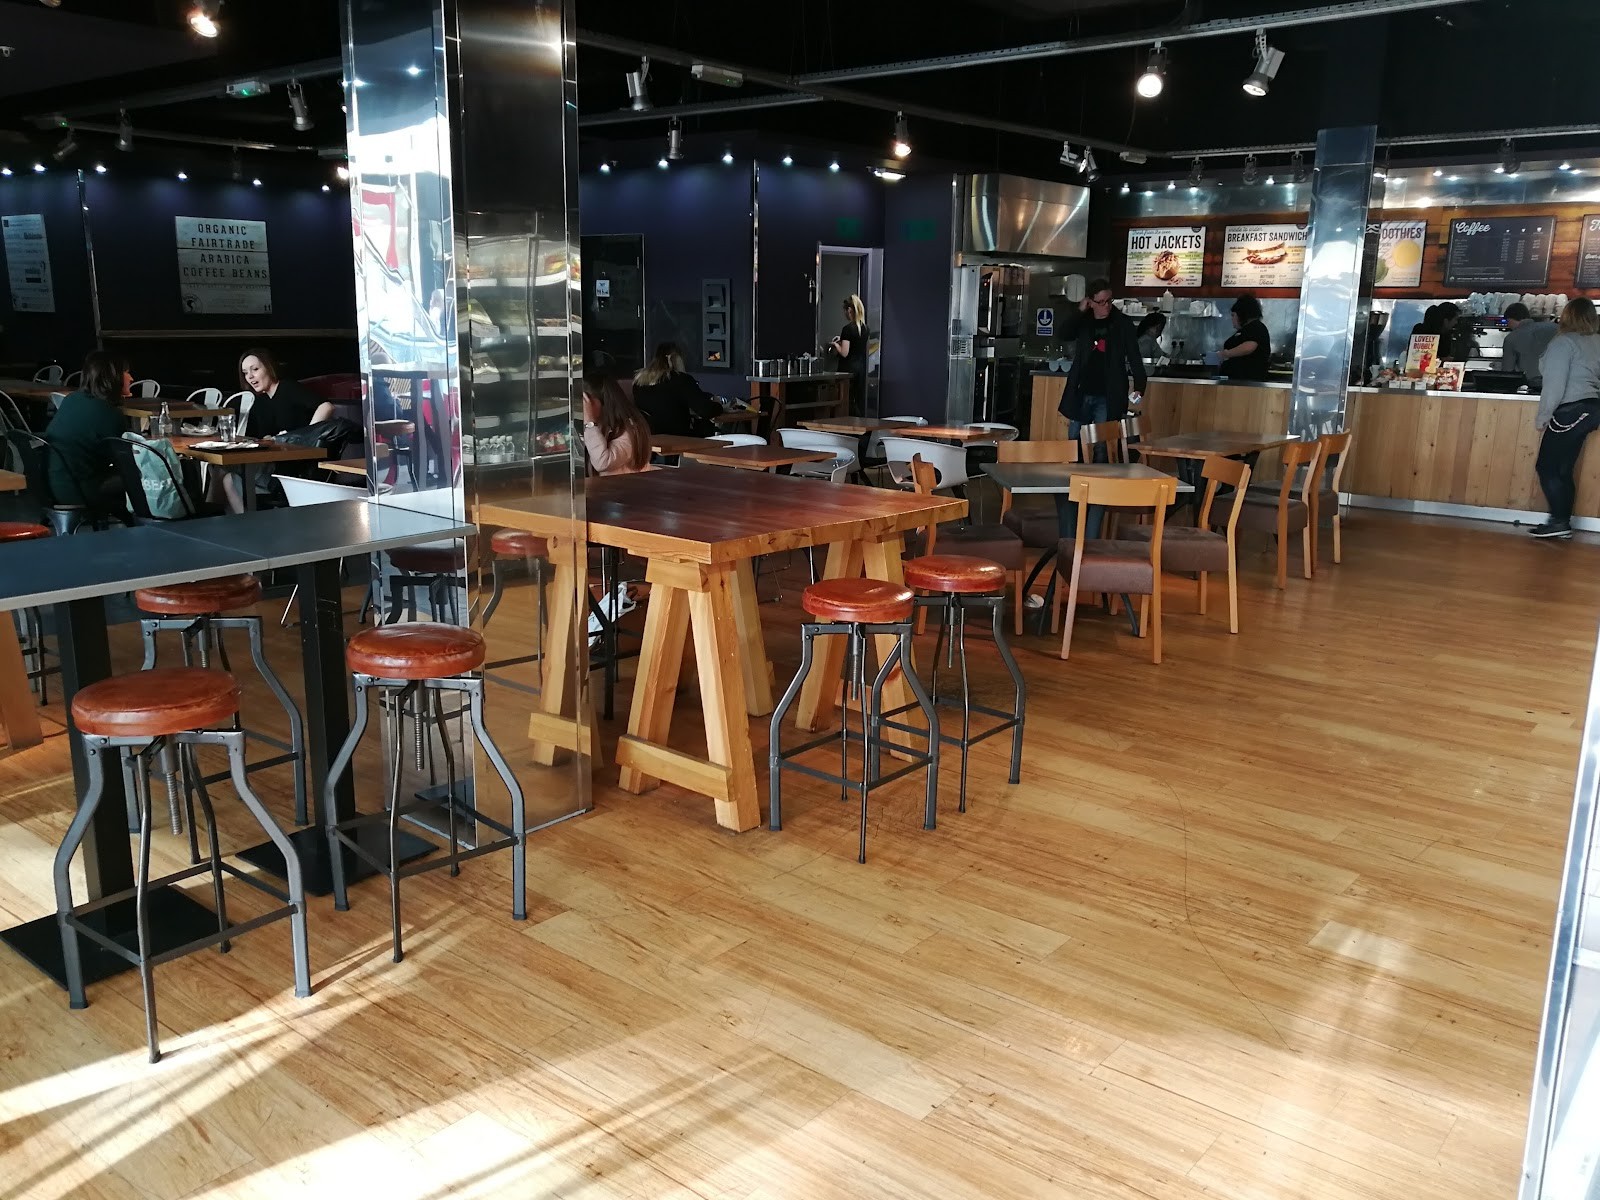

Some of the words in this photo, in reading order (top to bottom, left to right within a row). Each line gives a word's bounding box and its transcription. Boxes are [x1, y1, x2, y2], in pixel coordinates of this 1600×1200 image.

[197, 223, 247, 236] ORGANIC
[1381, 227, 1423, 239] OOTHIES
[1455, 221, 1491, 236] Coffee
[1131, 236, 1152, 250] HOT
[1154, 235, 1202, 249] JACKETS
[1227, 232, 1267, 243] BREAKFAST
[1268, 231, 1308, 242] SANDWICH
[191, 237, 255, 250] FAIRTRADE
[200, 253, 250, 265] ARABICA
[183, 267, 225, 278] COFFEE
[232, 268, 267, 279] BEANS
[1414, 335, 1436, 343] LOVELY
